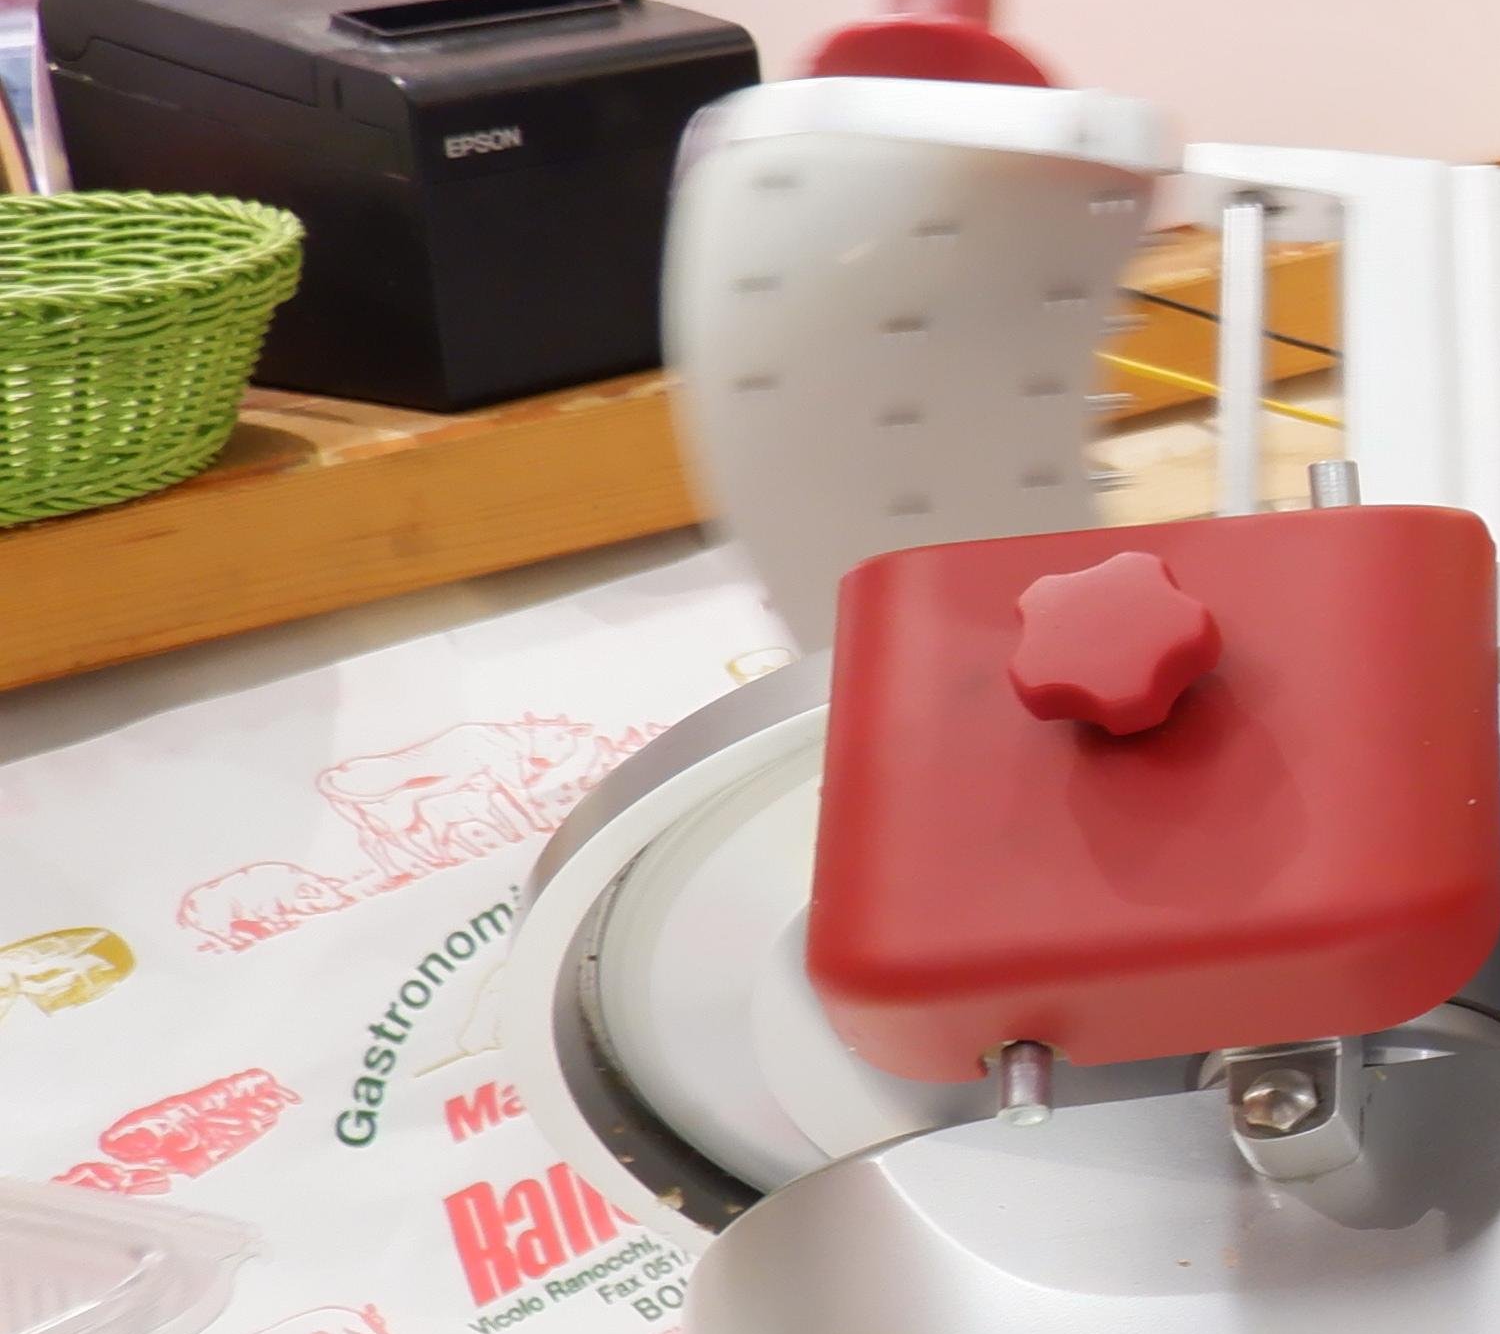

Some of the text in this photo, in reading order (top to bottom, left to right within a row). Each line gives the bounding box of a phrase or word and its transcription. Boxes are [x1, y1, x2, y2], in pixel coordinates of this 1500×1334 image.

[444, 127, 523, 159] EPSON
[335, 884, 521, 1148] Gastronom
[597, 1275, 643, 1305] Fax
[632, 1278, 688, 1322] BO
